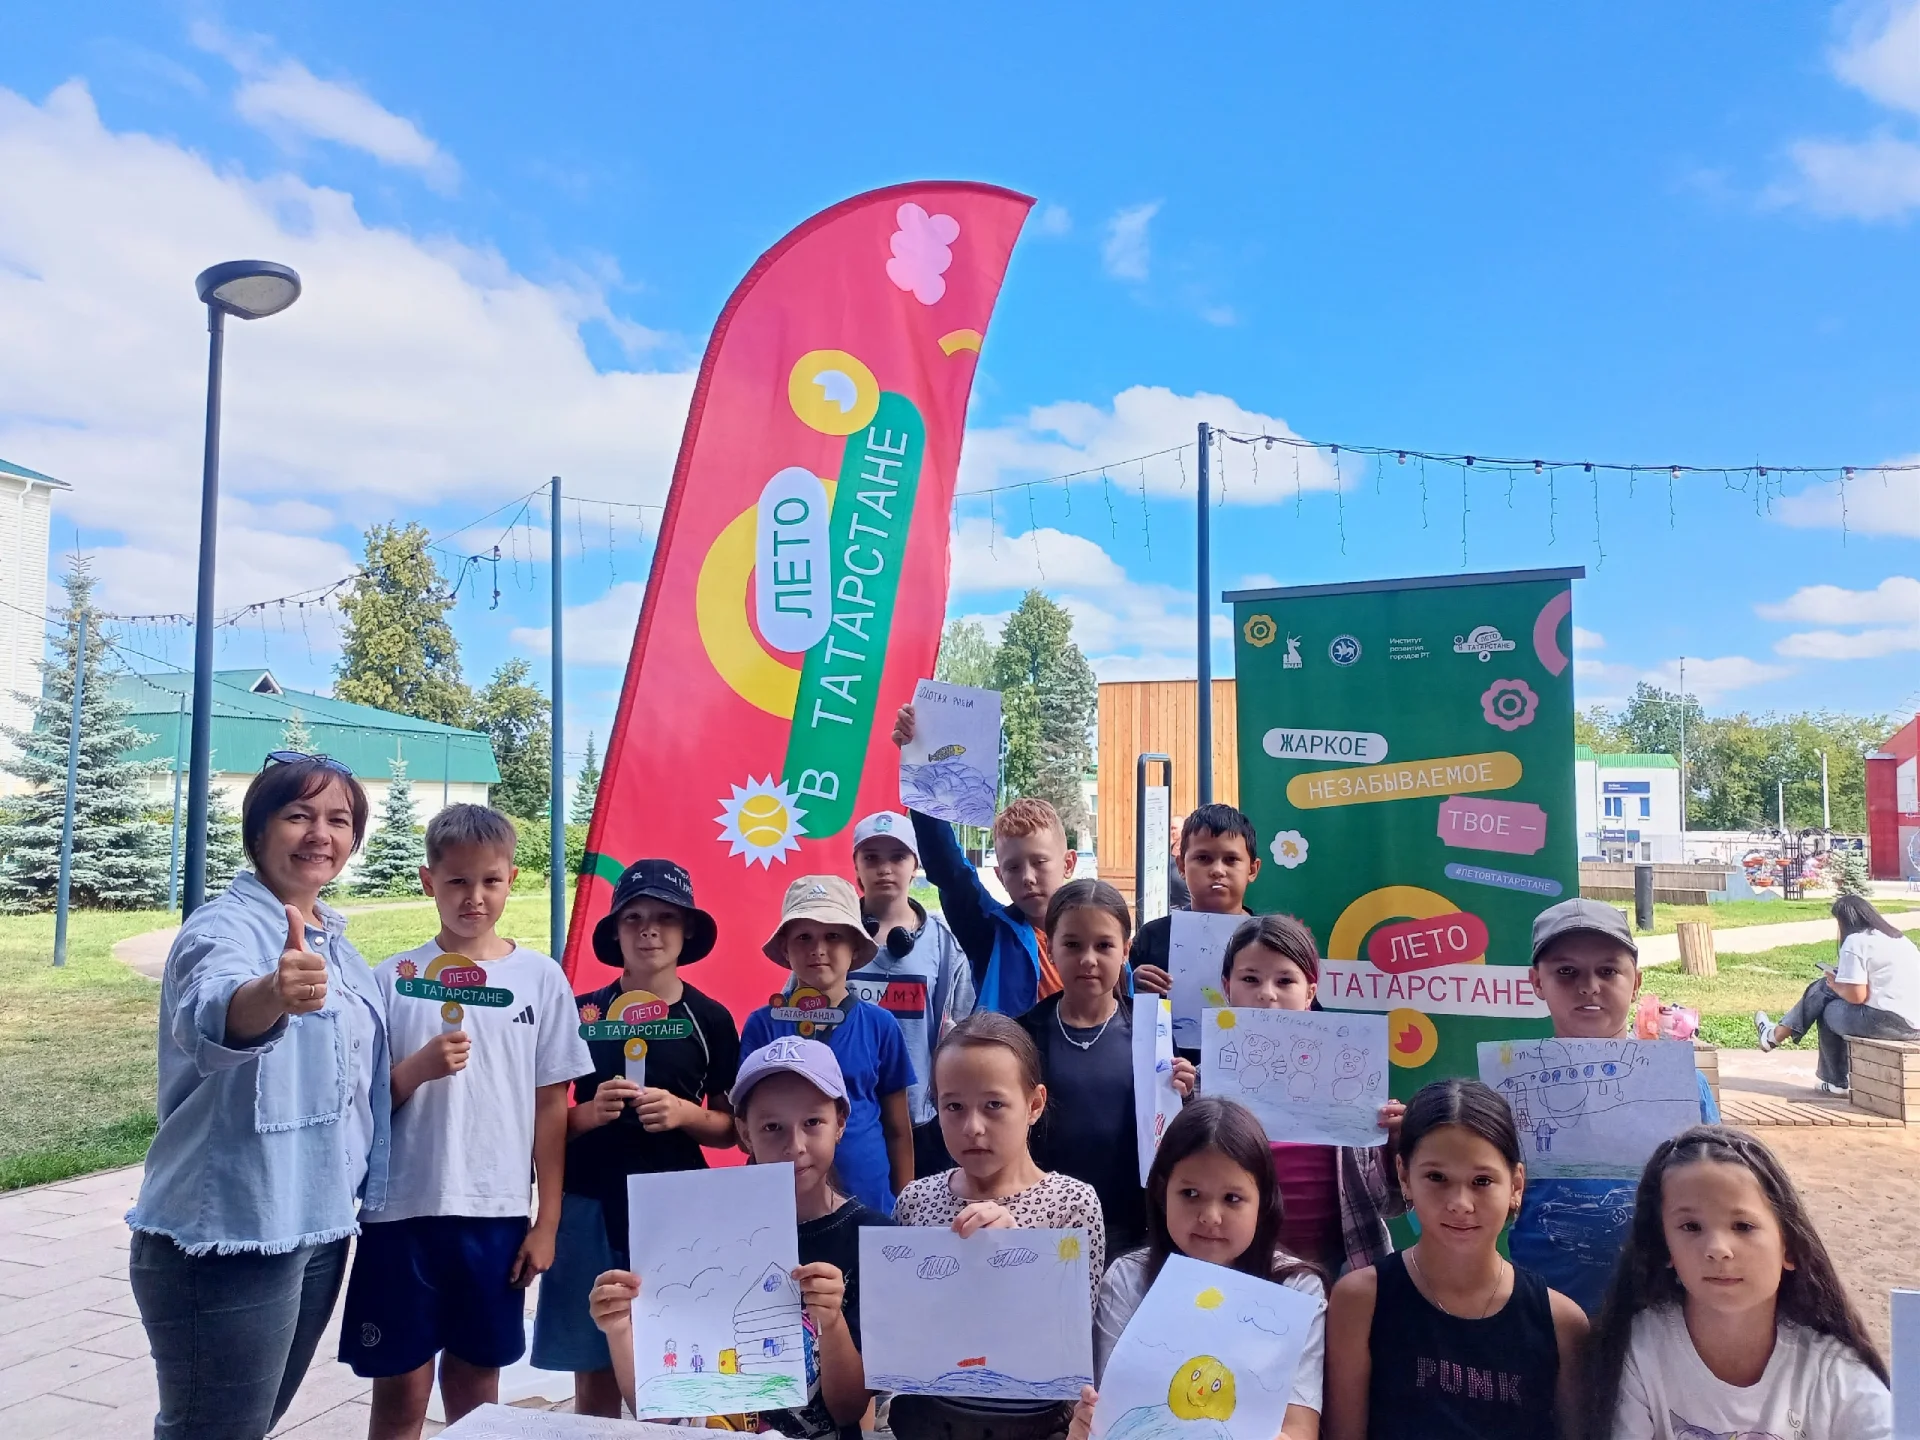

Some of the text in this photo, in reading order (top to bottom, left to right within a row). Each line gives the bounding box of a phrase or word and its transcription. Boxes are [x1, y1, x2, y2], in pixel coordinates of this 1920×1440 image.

[773, 498, 813, 619] ЛЕТО
[798, 427, 908, 801] В ТАТАРСТАНЕ
[1280, 733, 1368, 757] ЖАРКОЕ
[1309, 762, 1493, 801] НЕЗАБЫВАЕМОЕ
[1448, 810, 1510, 836] ТВОЕ
[1456, 868, 1551, 891] #ЛЕТОВТАТАРСТАНЕ
[1389, 926, 1468, 963] ЛЕТО
[448, 970, 480, 983] ЛЕТО
[1326, 971, 1535, 1006] ТАТАРСТАНЕ
[405, 982, 503, 1003] В ТАТАРСТАНЕ
[631, 1004, 661, 1021] ЛЕТО
[780, 1010, 835, 1020] ТАТАРСТАНДА
[588, 1024, 683, 1036] В ТАТАРСТАНЕ
[1416, 1356, 1522, 1405] PUNK
